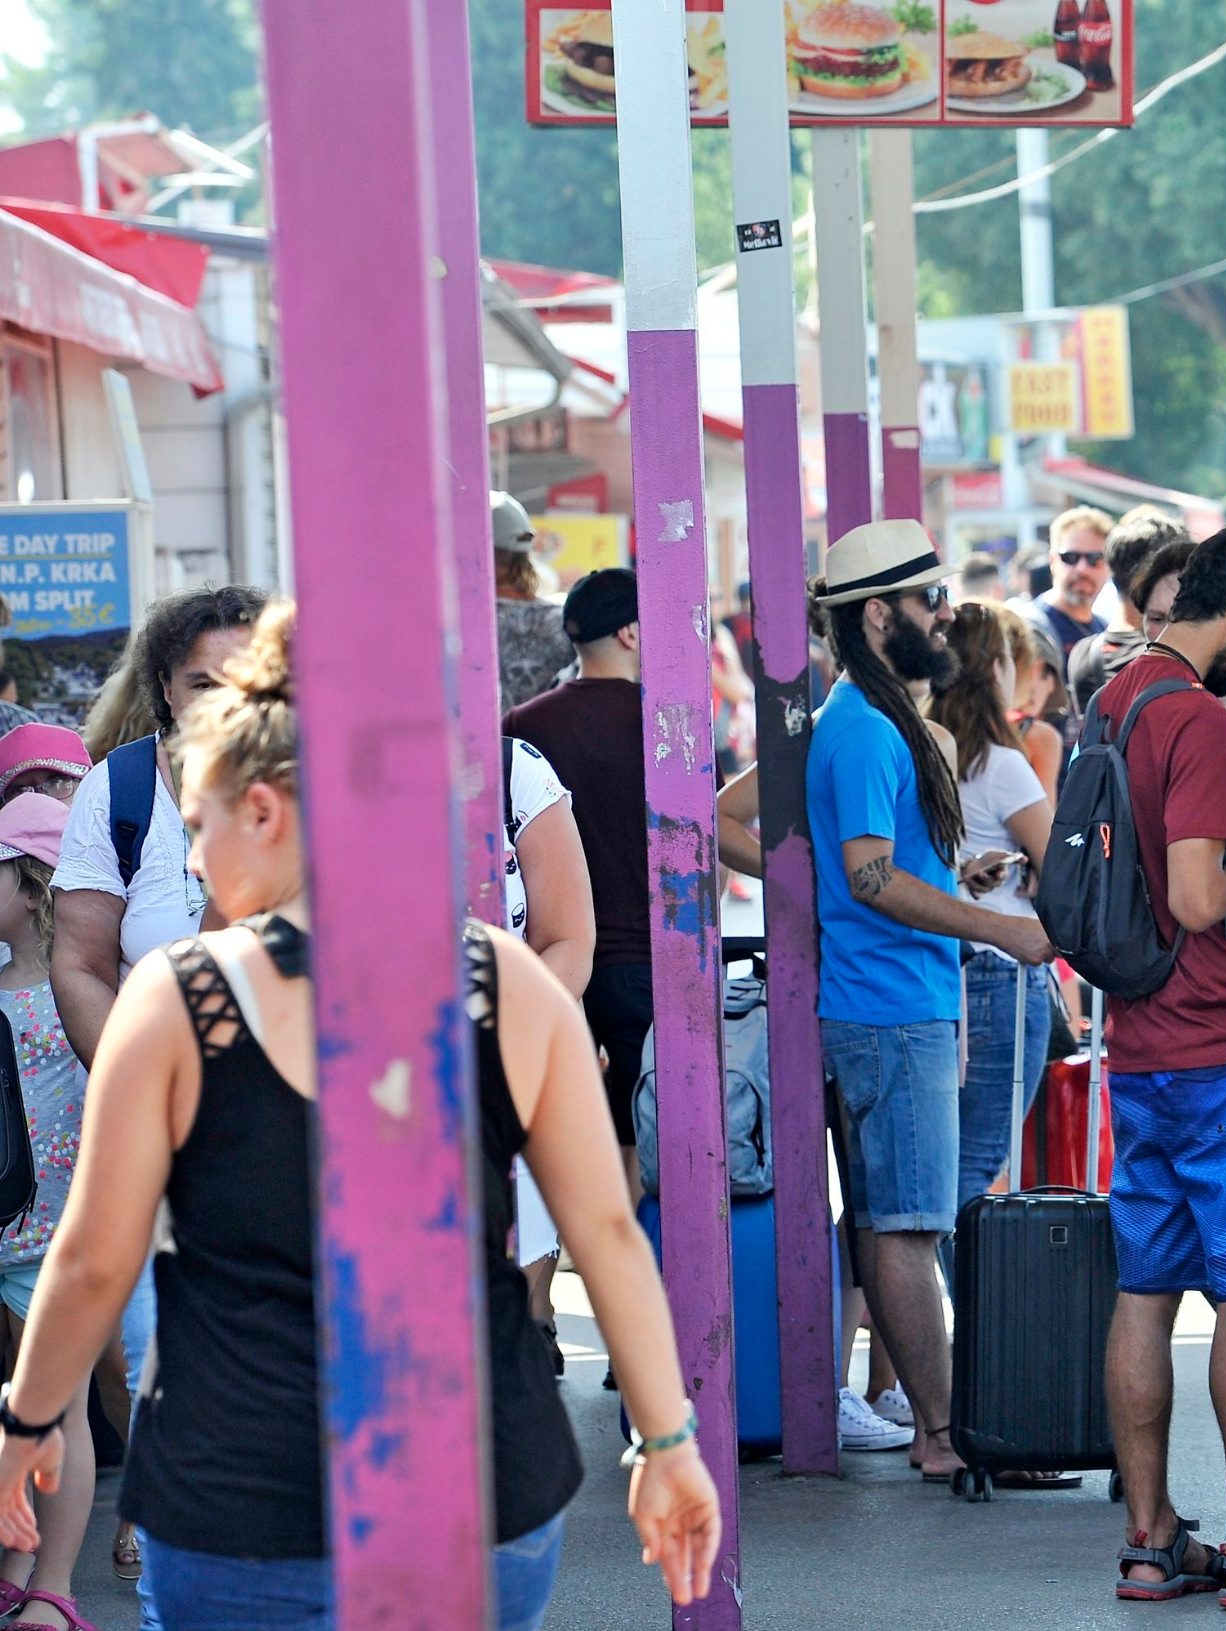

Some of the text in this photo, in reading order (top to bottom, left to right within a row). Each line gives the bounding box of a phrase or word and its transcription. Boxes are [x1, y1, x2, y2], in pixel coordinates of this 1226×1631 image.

[14, 534, 58, 555] DAY
[63, 533, 115, 555] TRIP
[51, 562, 116, 584] KRKA
[35, 589, 94, 612] SPLIT
